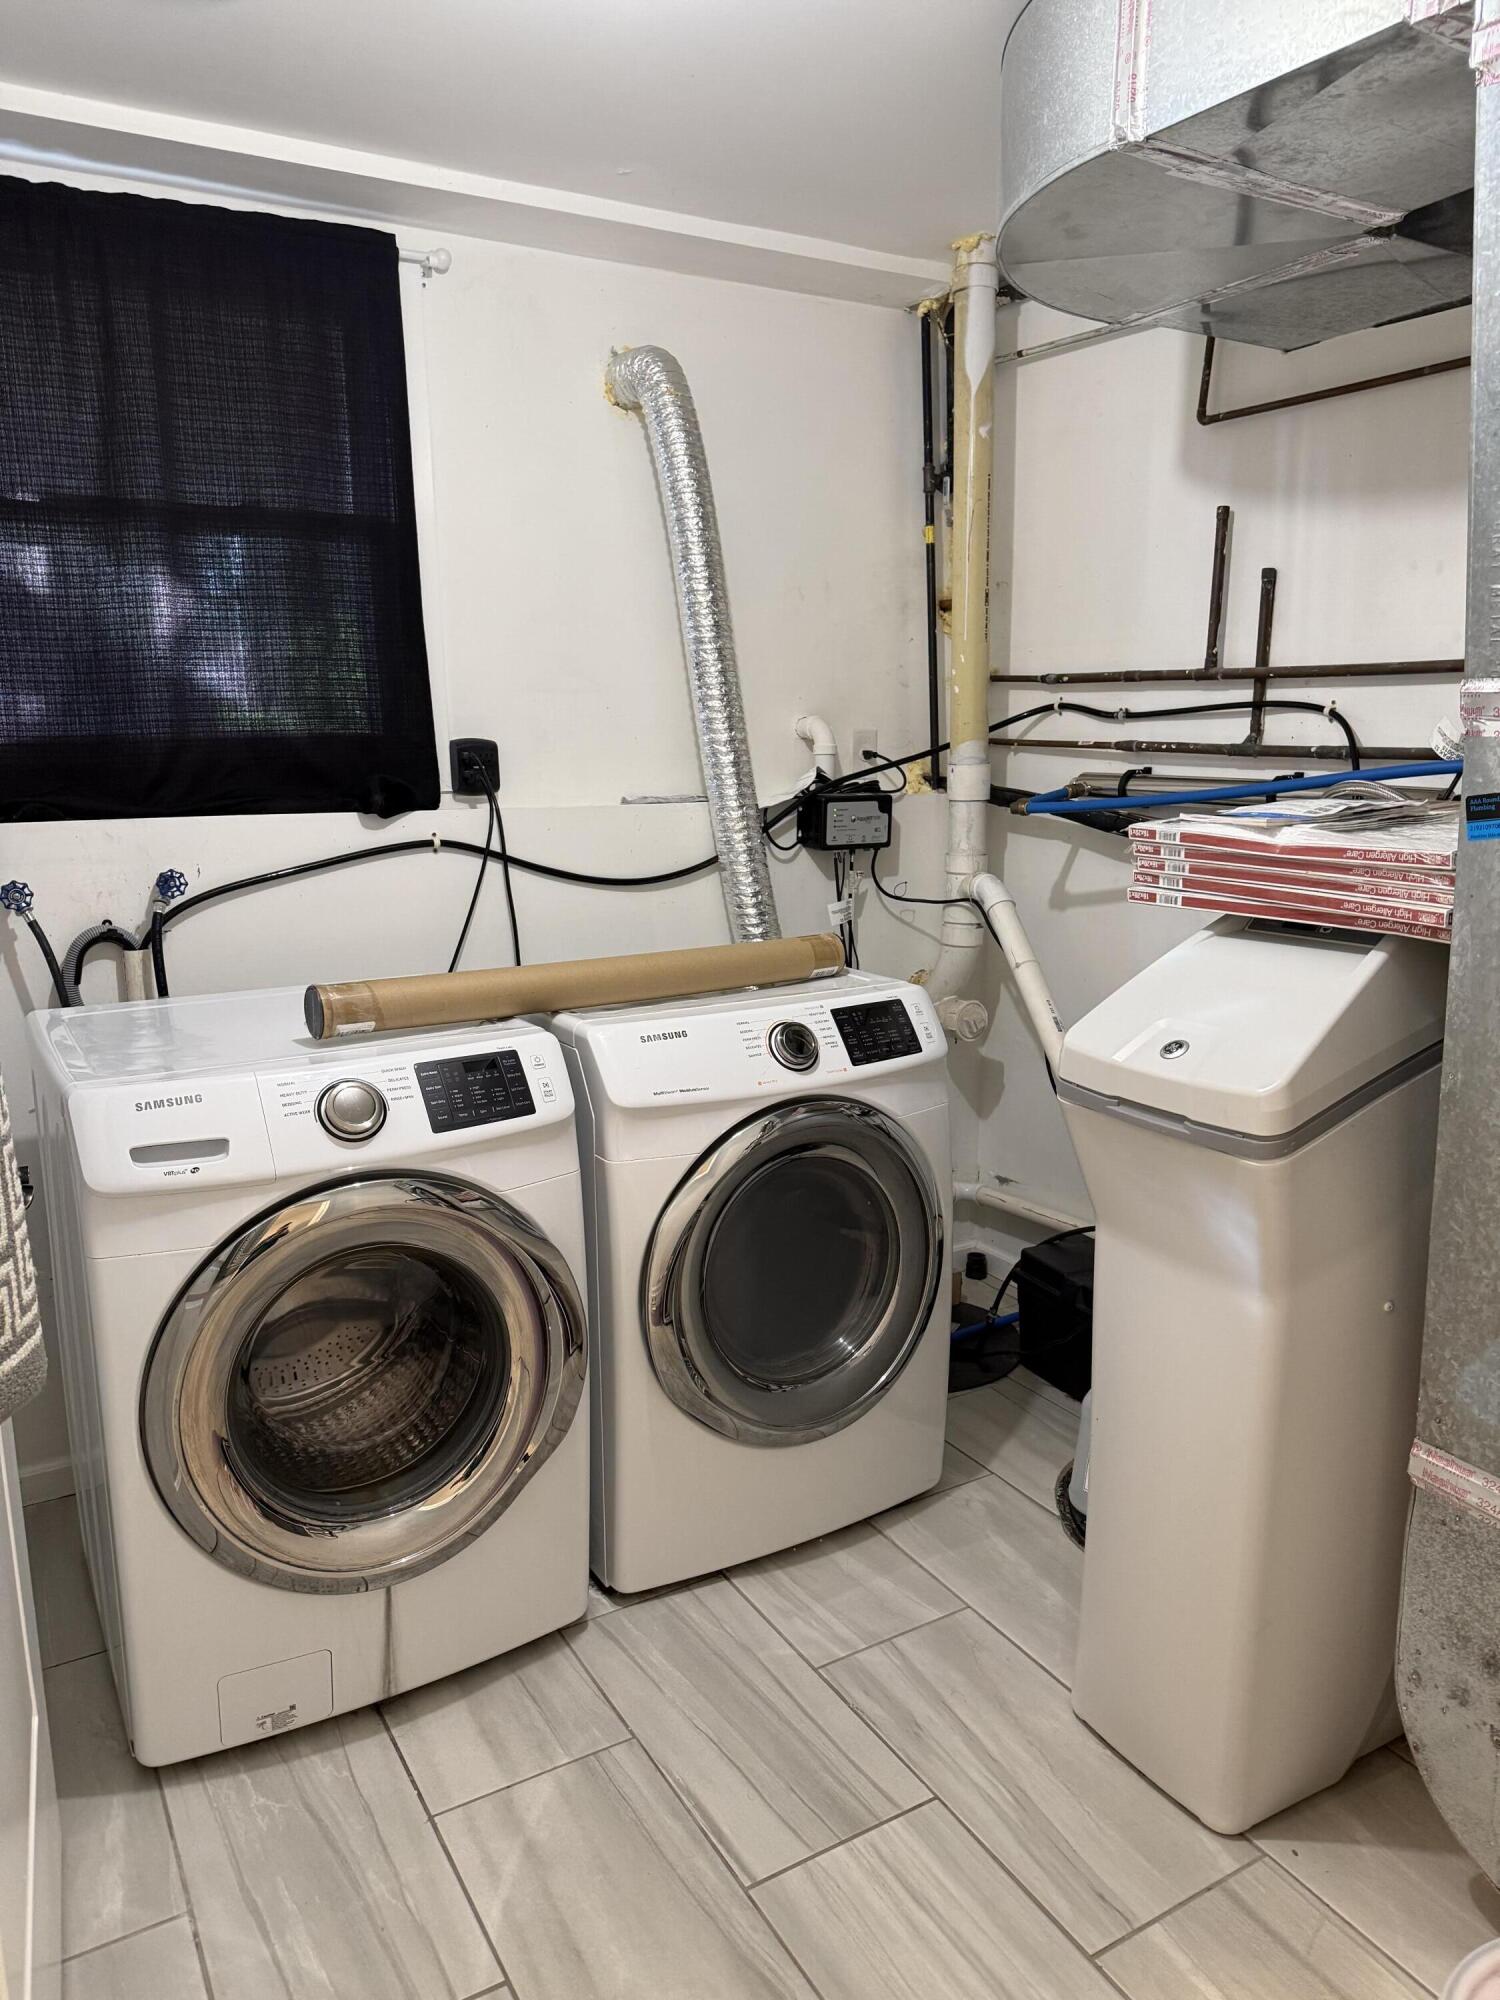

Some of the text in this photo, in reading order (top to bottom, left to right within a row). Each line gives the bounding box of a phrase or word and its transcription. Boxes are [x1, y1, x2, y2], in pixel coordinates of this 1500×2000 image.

[1398, 854, 1417, 864] High
[1343, 901, 1360, 911] Care
[1362, 902, 1393, 916] Allergen
[1394, 910, 1412, 920] High
[1357, 918, 1376, 928] Care
[1379, 920, 1410, 933] Allergen
[1412, 926, 1431, 937] High
[640, 1030, 688, 1044] SAMSUNG
[135, 1093, 203, 1112] SAMSUNG
